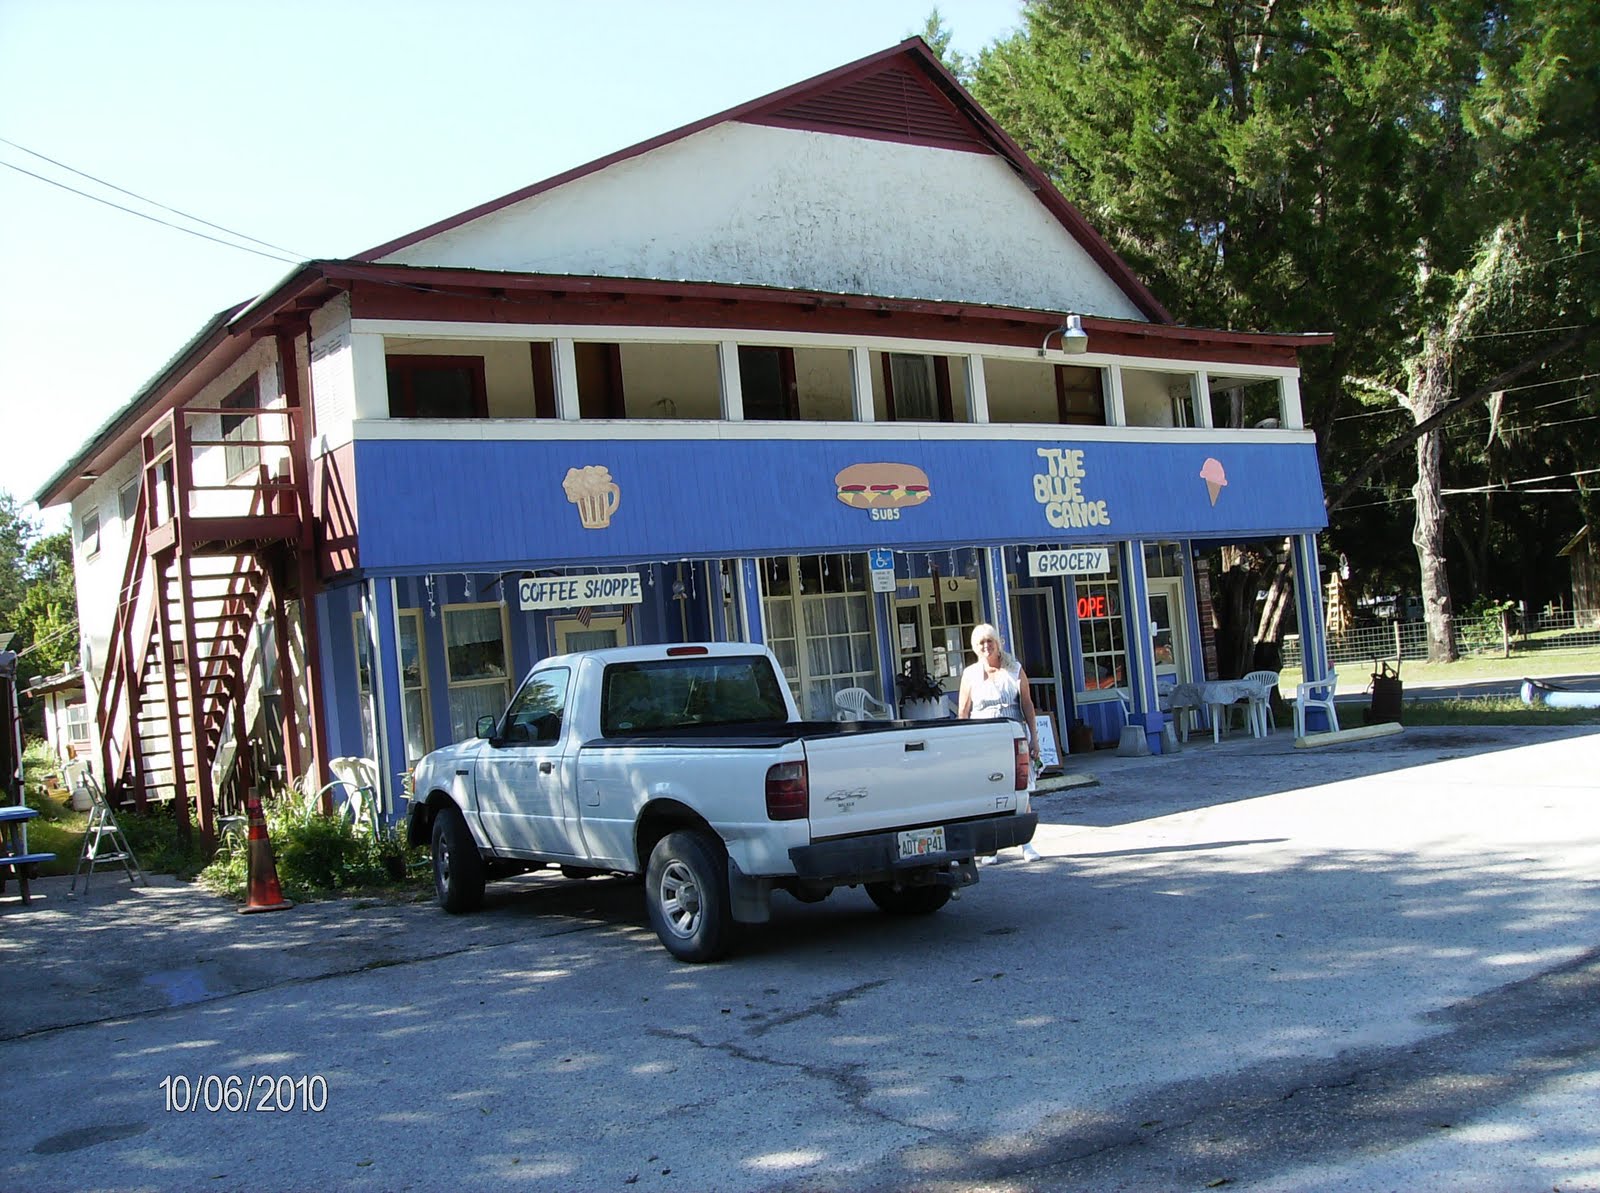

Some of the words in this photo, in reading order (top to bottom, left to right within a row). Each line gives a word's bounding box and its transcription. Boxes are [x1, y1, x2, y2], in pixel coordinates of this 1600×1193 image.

[1037, 448, 1085, 477] THE
[1033, 474, 1084, 503] BLUE
[871, 508, 900, 521] SUBS
[1045, 500, 1110, 529] CANOE
[1038, 552, 1102, 573] GROCERY
[520, 580, 579, 603] COFFEE
[584, 577, 640, 599] SHOPPE
